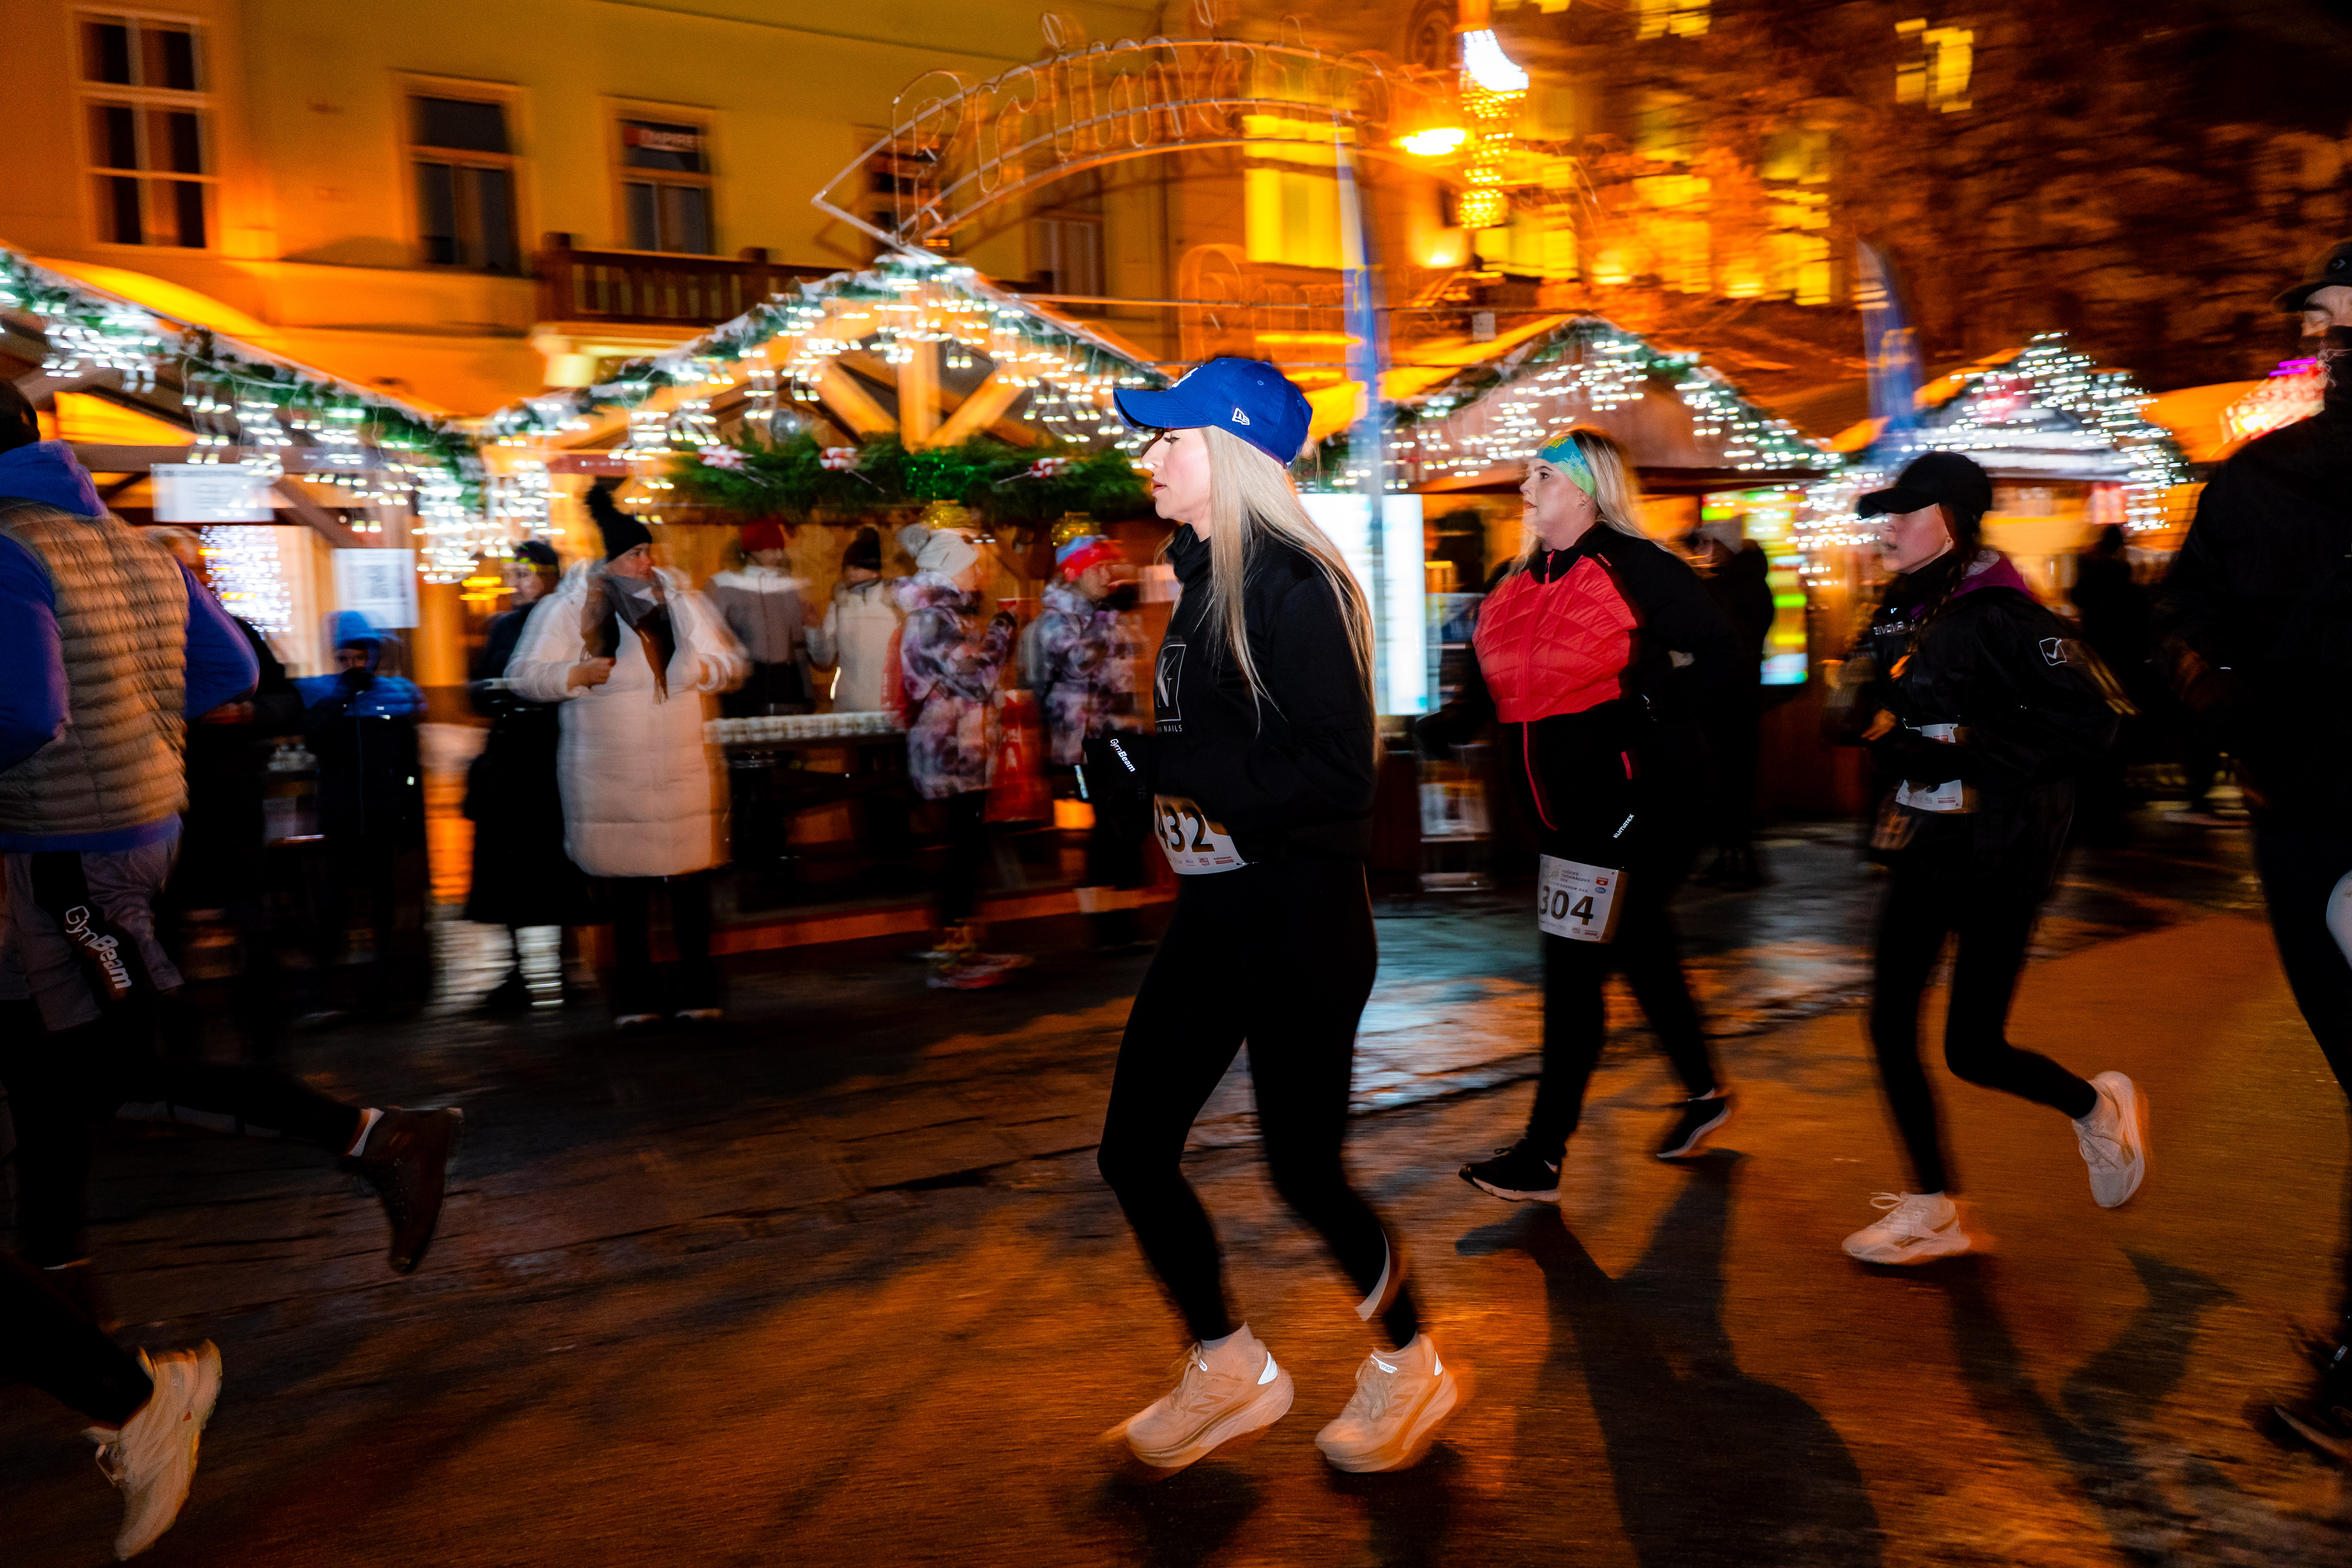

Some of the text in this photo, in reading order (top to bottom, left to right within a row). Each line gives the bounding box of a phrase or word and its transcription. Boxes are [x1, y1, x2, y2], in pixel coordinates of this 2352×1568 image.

[1110, 739, 1136, 772] GymBeam
[1613, 814, 1634, 838] KLIMATEX
[1539, 885, 1594, 926] 304
[66, 906, 132, 989] GymBeam
[1381, 1364, 1396, 1372] more
